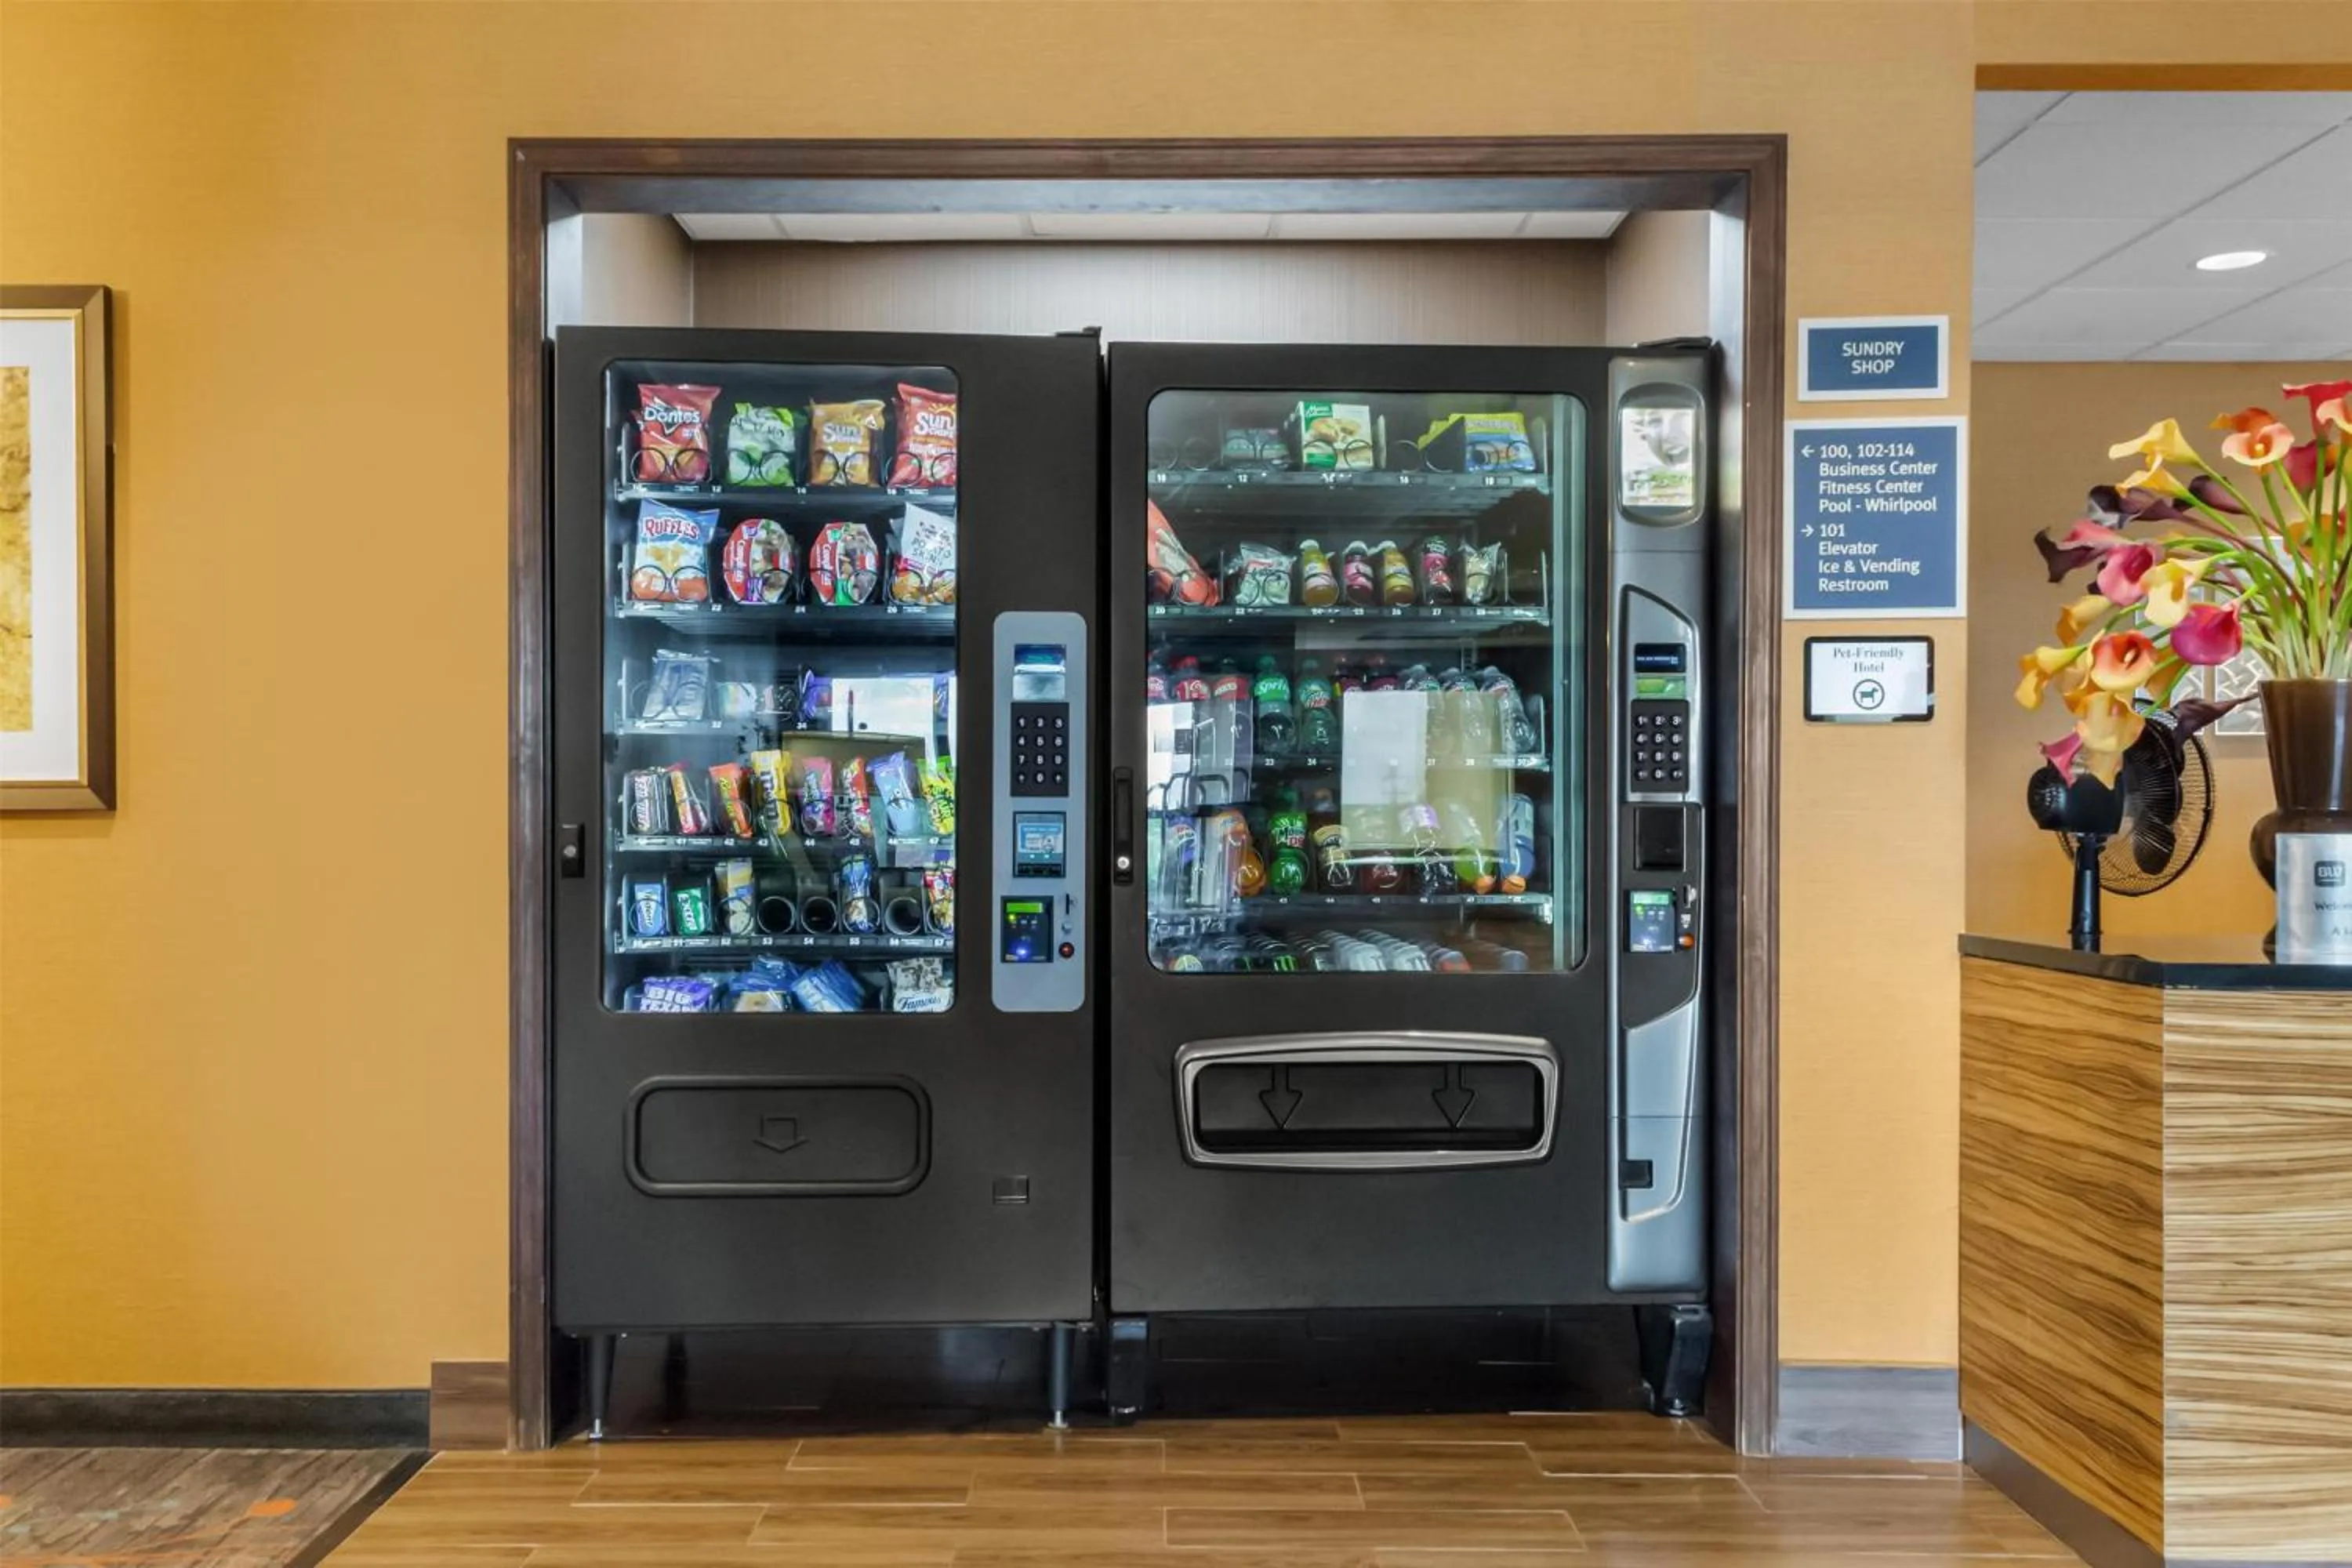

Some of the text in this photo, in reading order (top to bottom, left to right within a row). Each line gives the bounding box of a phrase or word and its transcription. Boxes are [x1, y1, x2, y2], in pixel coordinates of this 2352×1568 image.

[1842, 341, 1904, 356] SUNDRY
[1851, 360, 1895, 374] SHOP
[1820, 443, 1915, 459] 100, 102-114
[1819, 461, 1938, 477] Business Center
[1819, 480, 1924, 495] Fitness Center
[1819, 499, 1852, 513] Pool
[1864, 496, 1937, 514] Whirlpool
[644, 517, 699, 539] RUFFLES
[1820, 524, 1845, 537] 101
[1819, 542, 1879, 555] Elevator
[1818, 558, 1921, 576] Ice & Vending
[1818, 579, 1889, 592] Restroom
[1833, 647, 1904, 660] Pet-Friendly
[1853, 662, 1885, 673] Hotel
